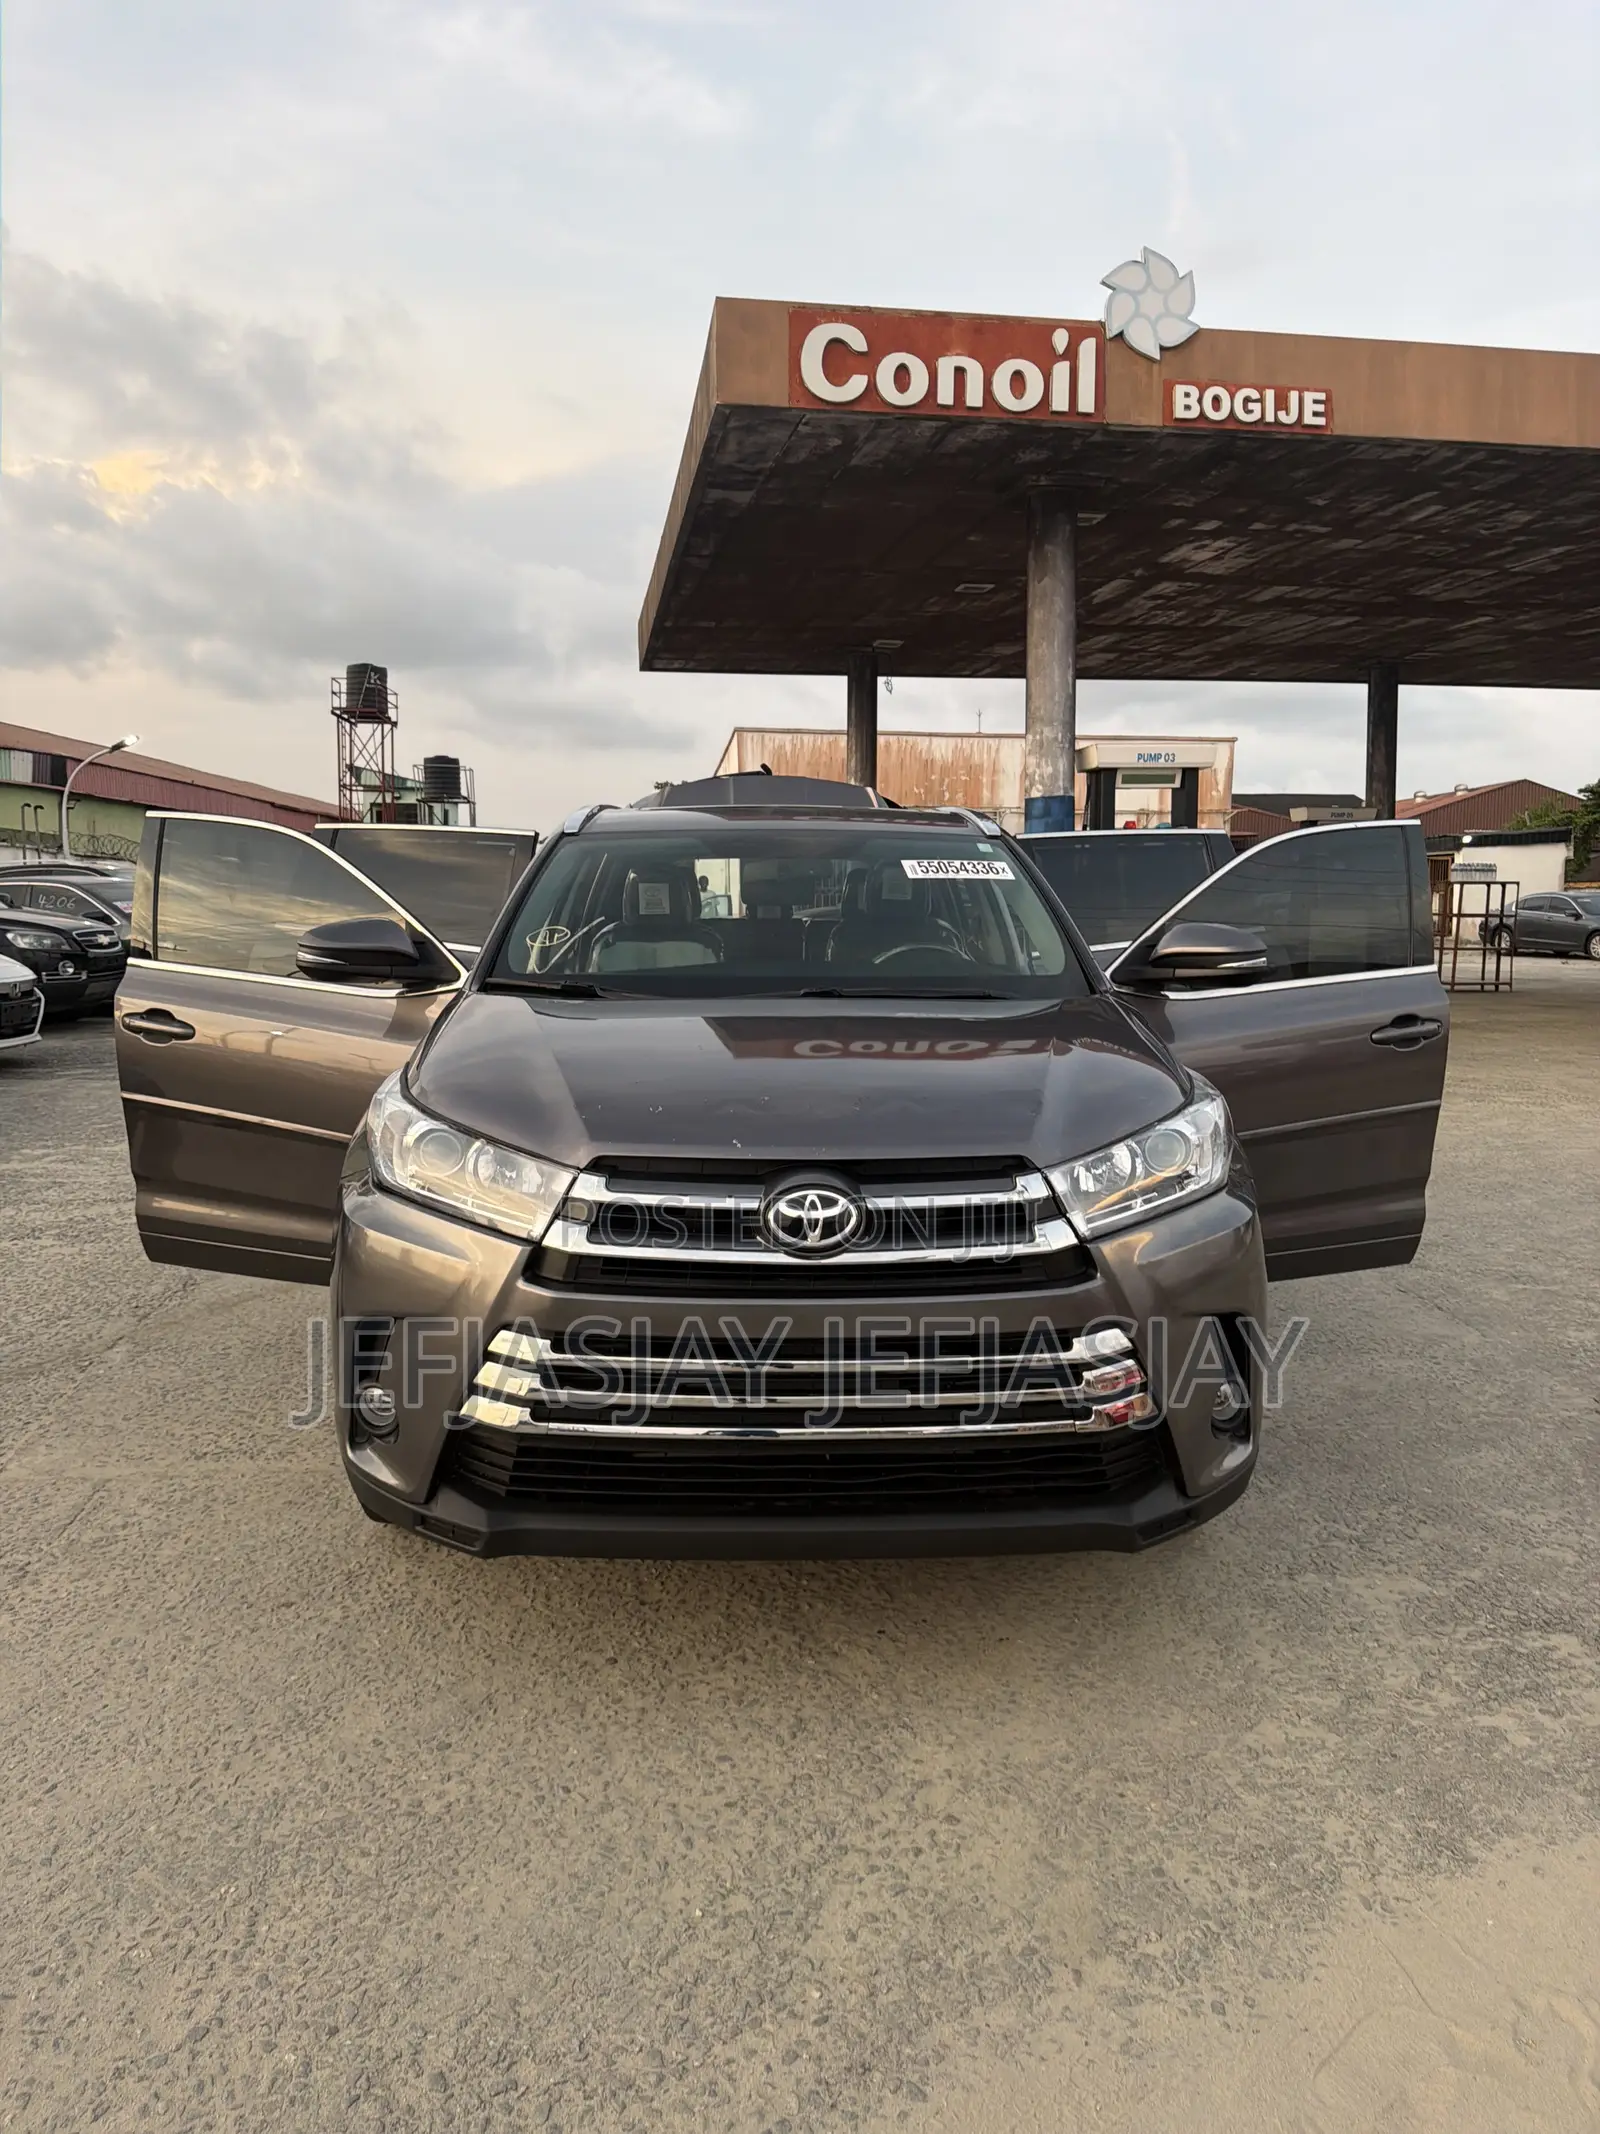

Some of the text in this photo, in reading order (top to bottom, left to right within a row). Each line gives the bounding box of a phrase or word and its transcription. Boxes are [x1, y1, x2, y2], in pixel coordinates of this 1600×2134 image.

[799, 322, 1096, 414] Conoil
[1172, 383, 1328, 427] BOGIJE
[1136, 752, 1176, 763] PUMP 03
[916, 860, 1000, 875] 55054336
[38, 894, 76, 909] 4206
